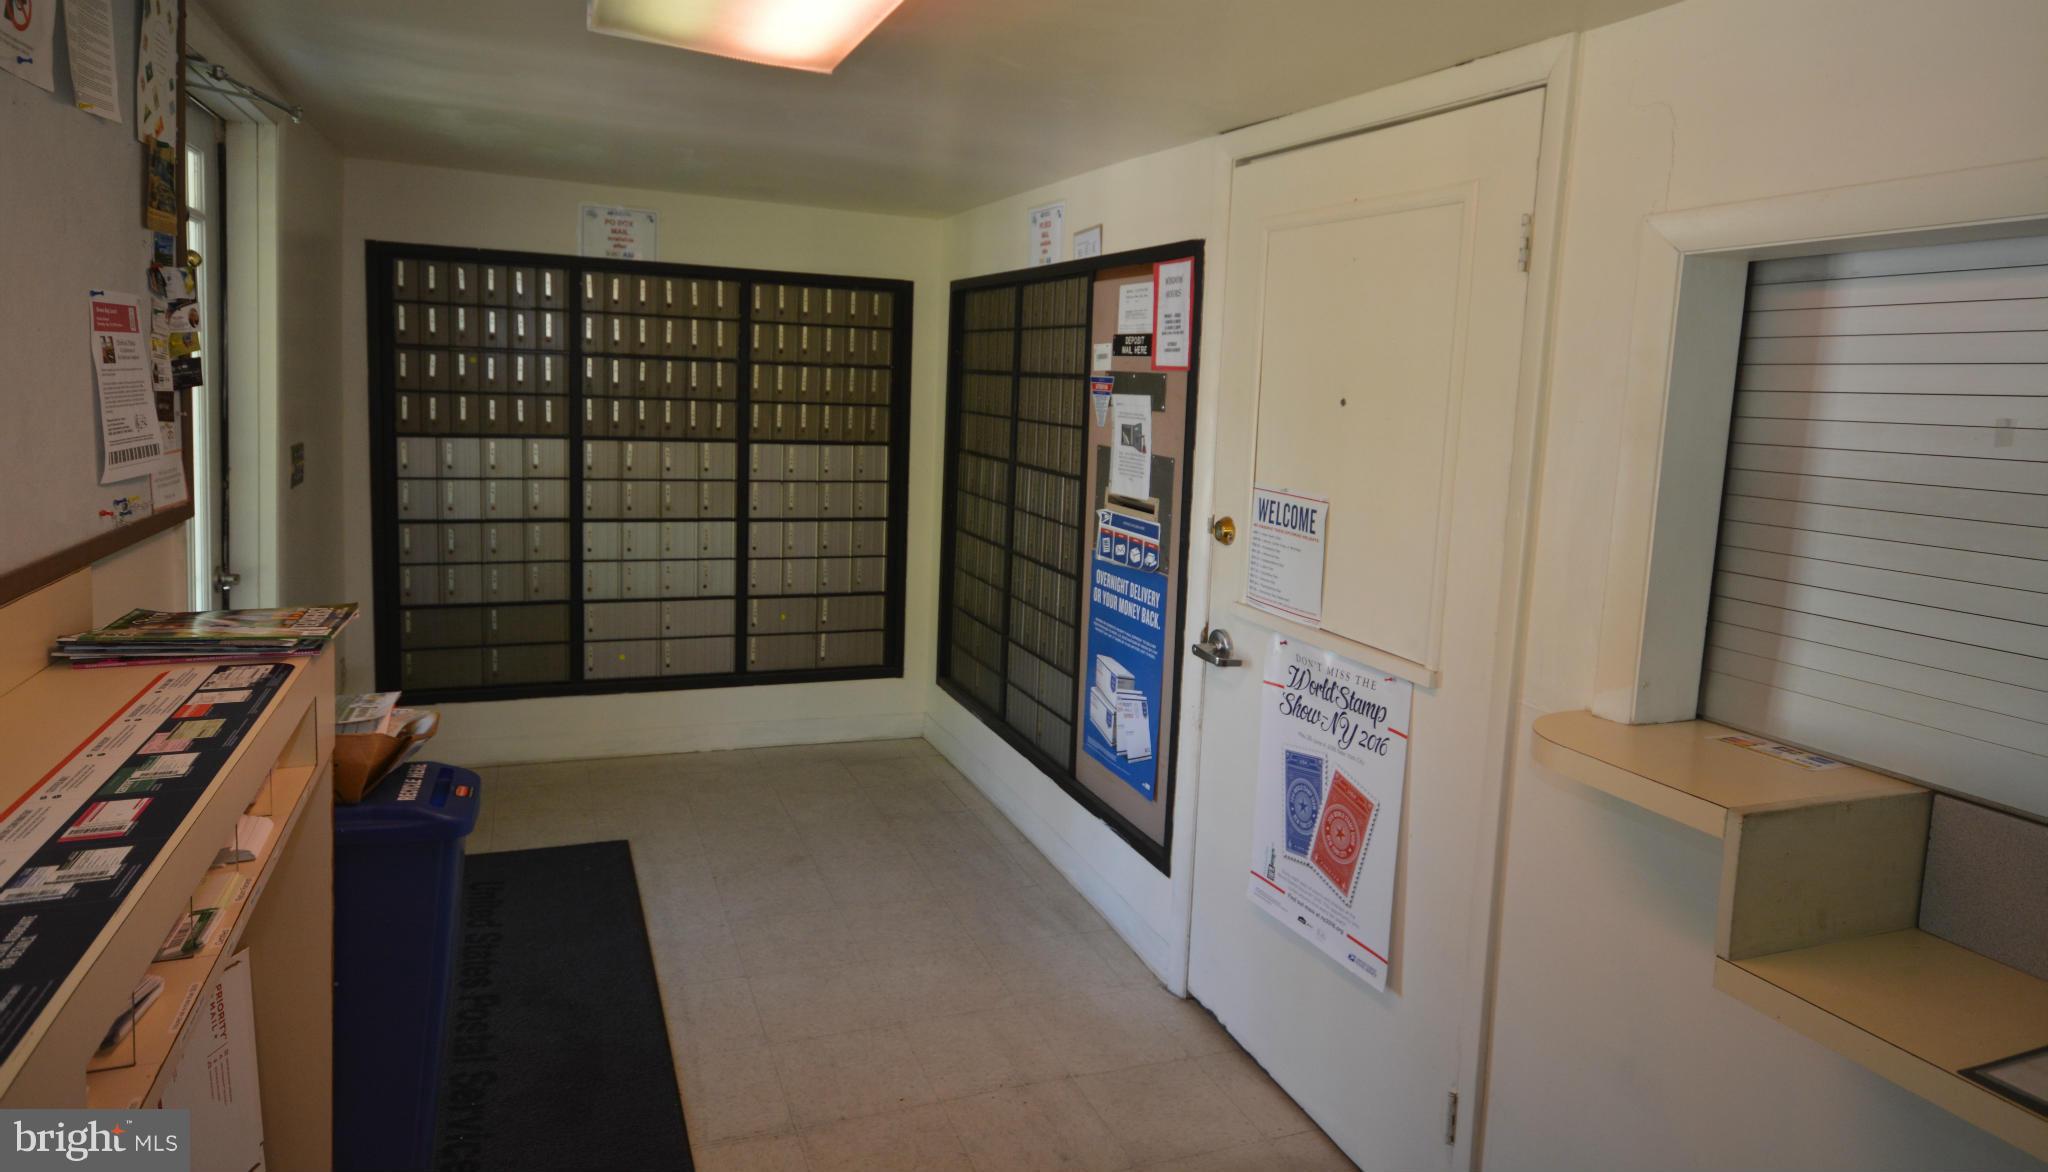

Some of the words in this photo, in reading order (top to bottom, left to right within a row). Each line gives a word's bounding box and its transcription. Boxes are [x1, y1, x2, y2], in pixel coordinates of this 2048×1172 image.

[1121, 345, 1133, 355] MAIL
[1134, 345, 1148, 355] HERE
[1125, 335, 1145, 345] DEPOSIT
[1258, 497, 1318, 535] WELCOME
[1096, 569, 1129, 596] OVERNIGHT
[1129, 582, 1160, 608] DELIVERY
[1093, 587, 1102, 603] OR
[1102, 589, 1118, 611] YOUR
[1118, 597, 1141, 621] MONEY
[1141, 607, 1161, 630] BACK.
[1296, 653, 1323, 672] DON'T
[1327, 666, 1351, 681] MISS
[1355, 674, 1377, 692] THE
[1287, 665, 1337, 704] World
[1335, 685, 1388, 729] Stamp
[1359, 730, 1391, 756] 2016
[397, 778, 422, 801] RECYCLE
[406, 763, 428, 779] HERE
[466, 880, 504, 928] United
[459, 931, 503, 989] States
[215, 983, 228, 1040] PRIORITY
[453, 993, 501, 1063] Postal
